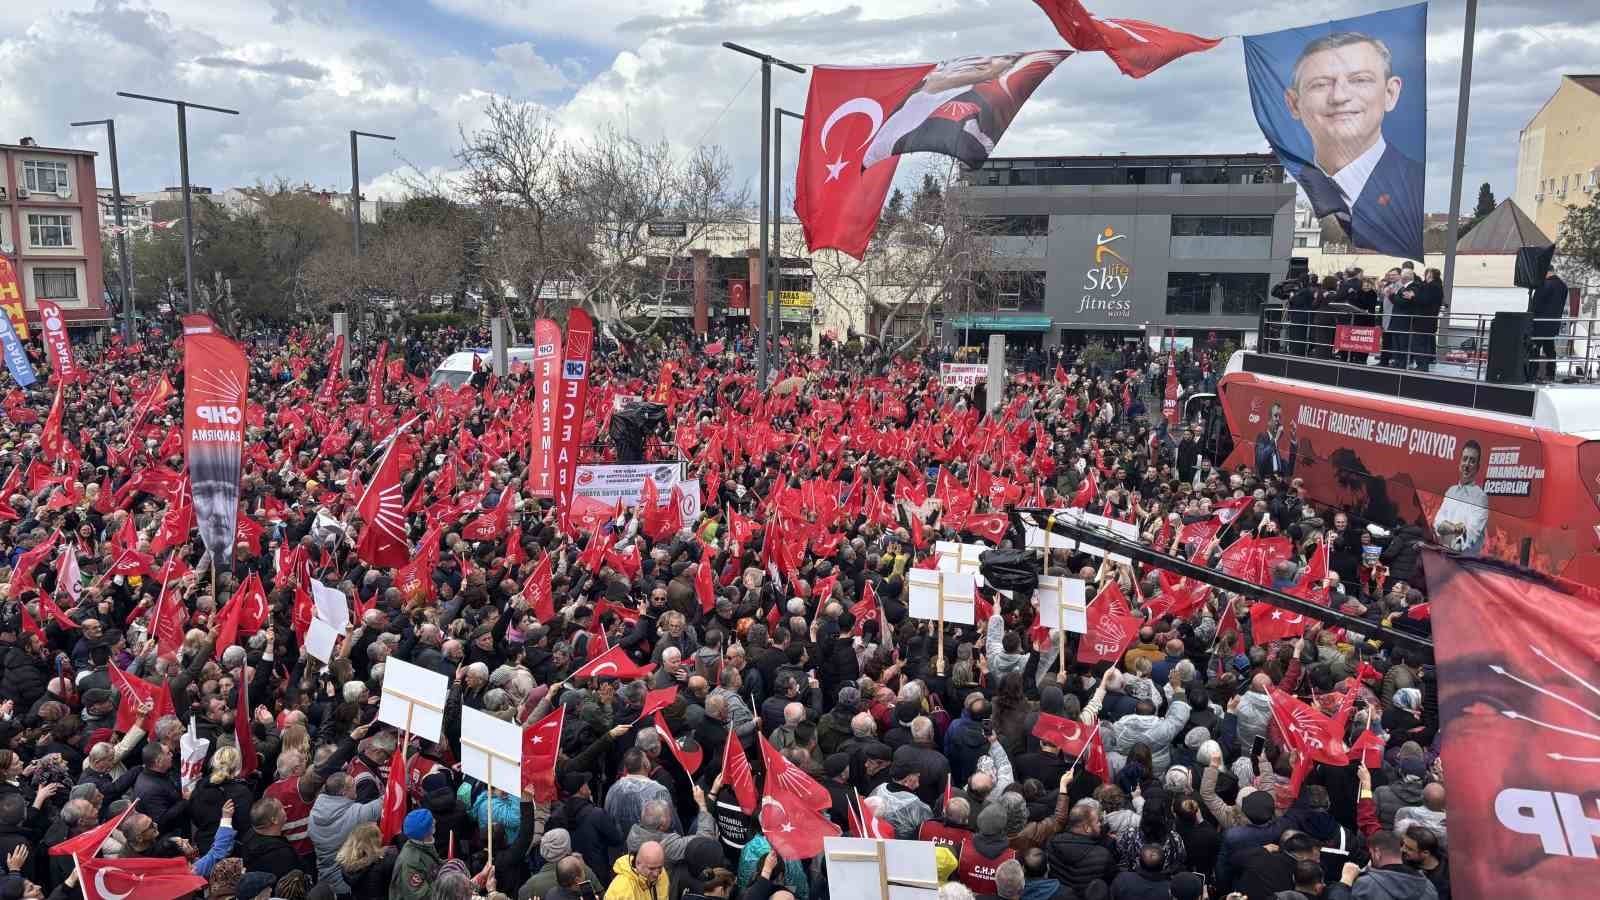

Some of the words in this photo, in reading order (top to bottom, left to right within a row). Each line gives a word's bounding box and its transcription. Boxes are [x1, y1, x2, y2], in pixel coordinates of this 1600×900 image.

[1083, 267, 1129, 297] Sky
[1075, 295, 1131, 313] fitness
[1298, 404, 1328, 432] MİLLET
[1328, 411, 1376, 442] İRADESİNE
[1376, 421, 1409, 449] SAHİP
[1408, 429, 1457, 461] ÇIKIYOR
[1488, 452, 1520, 465] EKREM
